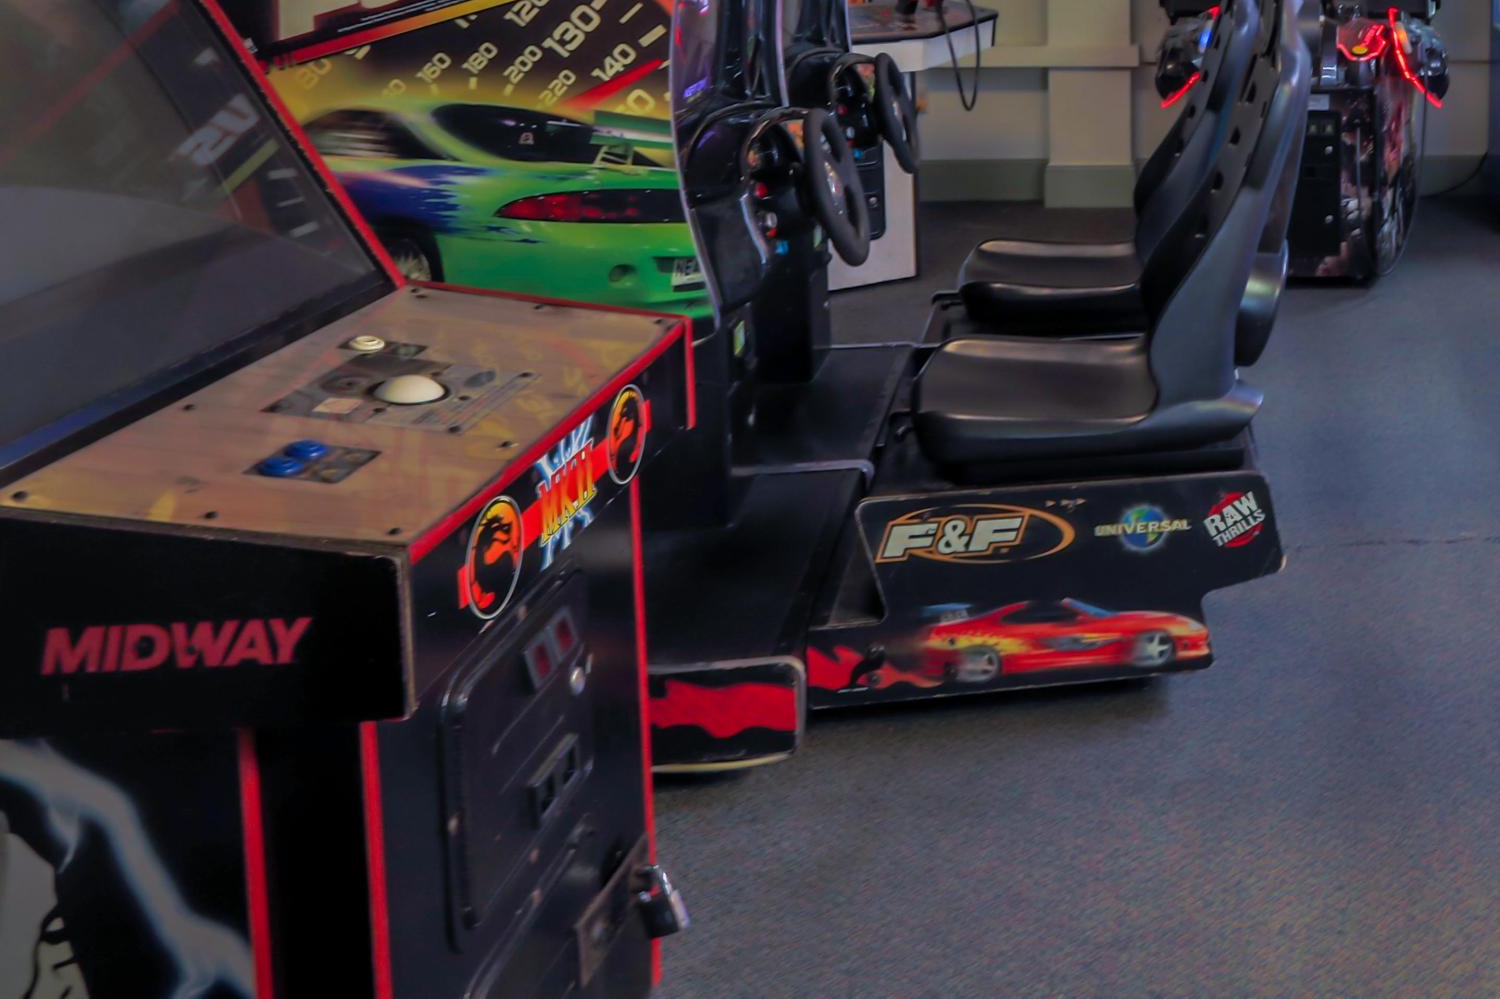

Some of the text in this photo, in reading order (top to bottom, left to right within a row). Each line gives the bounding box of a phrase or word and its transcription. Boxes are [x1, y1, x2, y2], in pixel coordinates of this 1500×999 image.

[542, 4, 602, 59] 130
[415, 51, 452, 83] 160
[461, 41, 498, 76] 180
[503, 45, 544, 85] 200
[590, 42, 638, 83] 140
[1094, 518, 1193, 537] UNIVERSAL
[1203, 491, 1258, 537] RAW
[1212, 508, 1266, 547] THRILLS
[881, 515, 1023, 559] F&F
[41, 616, 313, 675] MIDWAY
